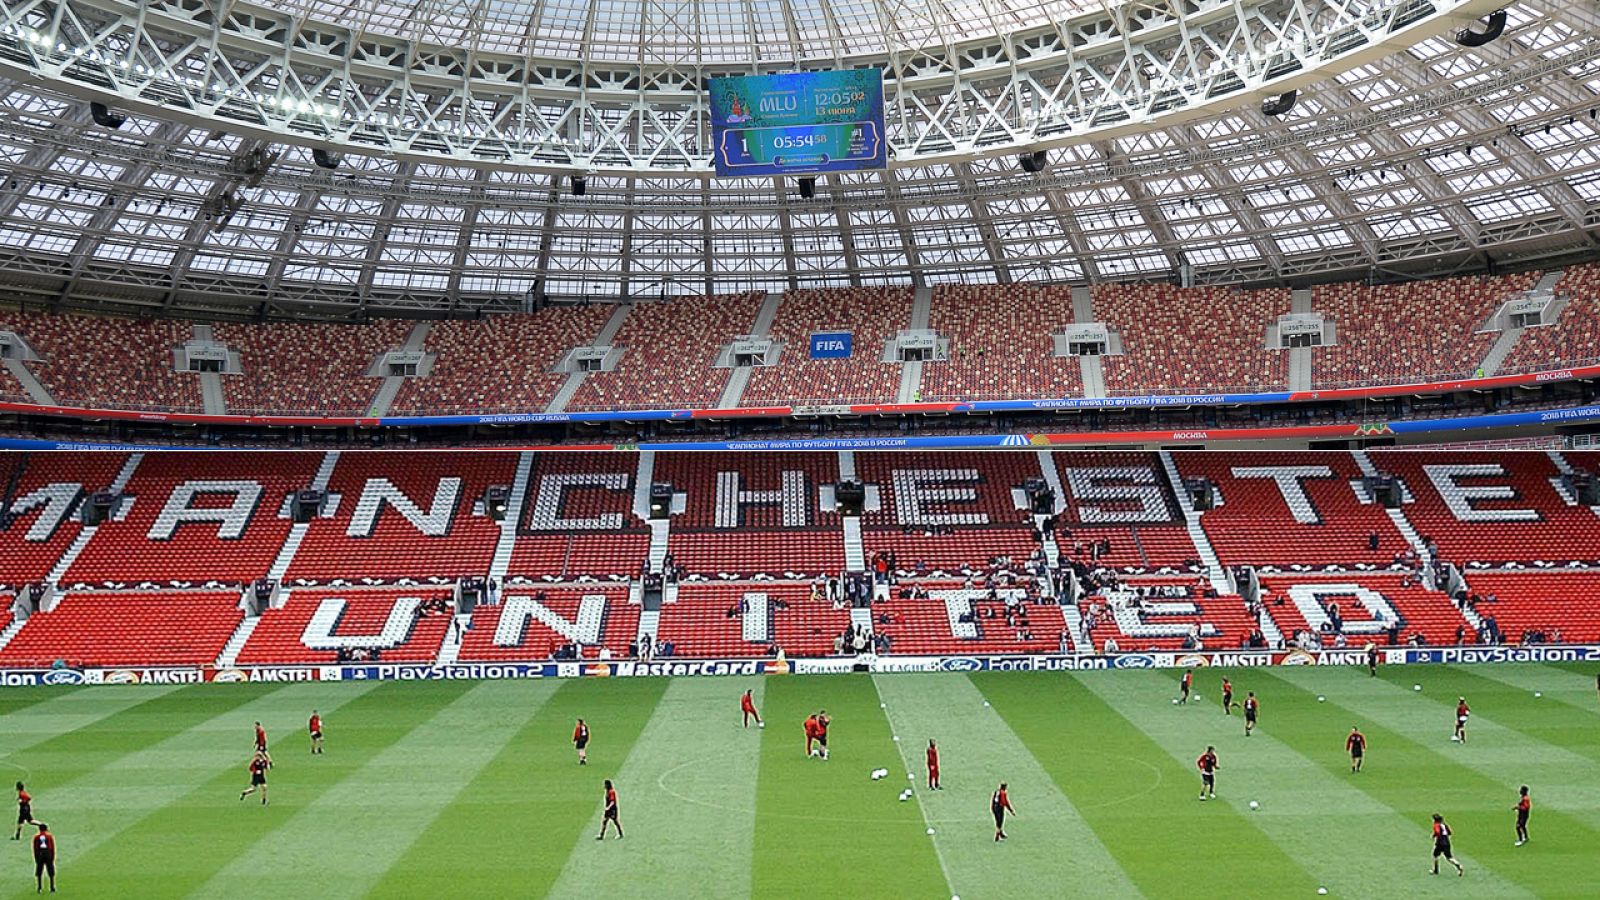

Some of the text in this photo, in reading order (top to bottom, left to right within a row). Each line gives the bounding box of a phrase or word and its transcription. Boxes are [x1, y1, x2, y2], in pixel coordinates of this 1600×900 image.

[760, 96, 797, 112] MLU
[740, 138, 748, 152] 1
[773, 135, 814, 149] 05:54
[815, 341, 845, 351] FIFA
[1535, 371, 1573, 381] МОСКВА
[1168, 397, 1186, 405] 2018
[1560, 410, 1578, 418] FIFA
[1173, 431, 1207, 440] МОСКВА
[301, 583, 1406, 648] UNITED
[616, 661, 757, 676] MasterCard
[0, 671, 37, 686] ion
